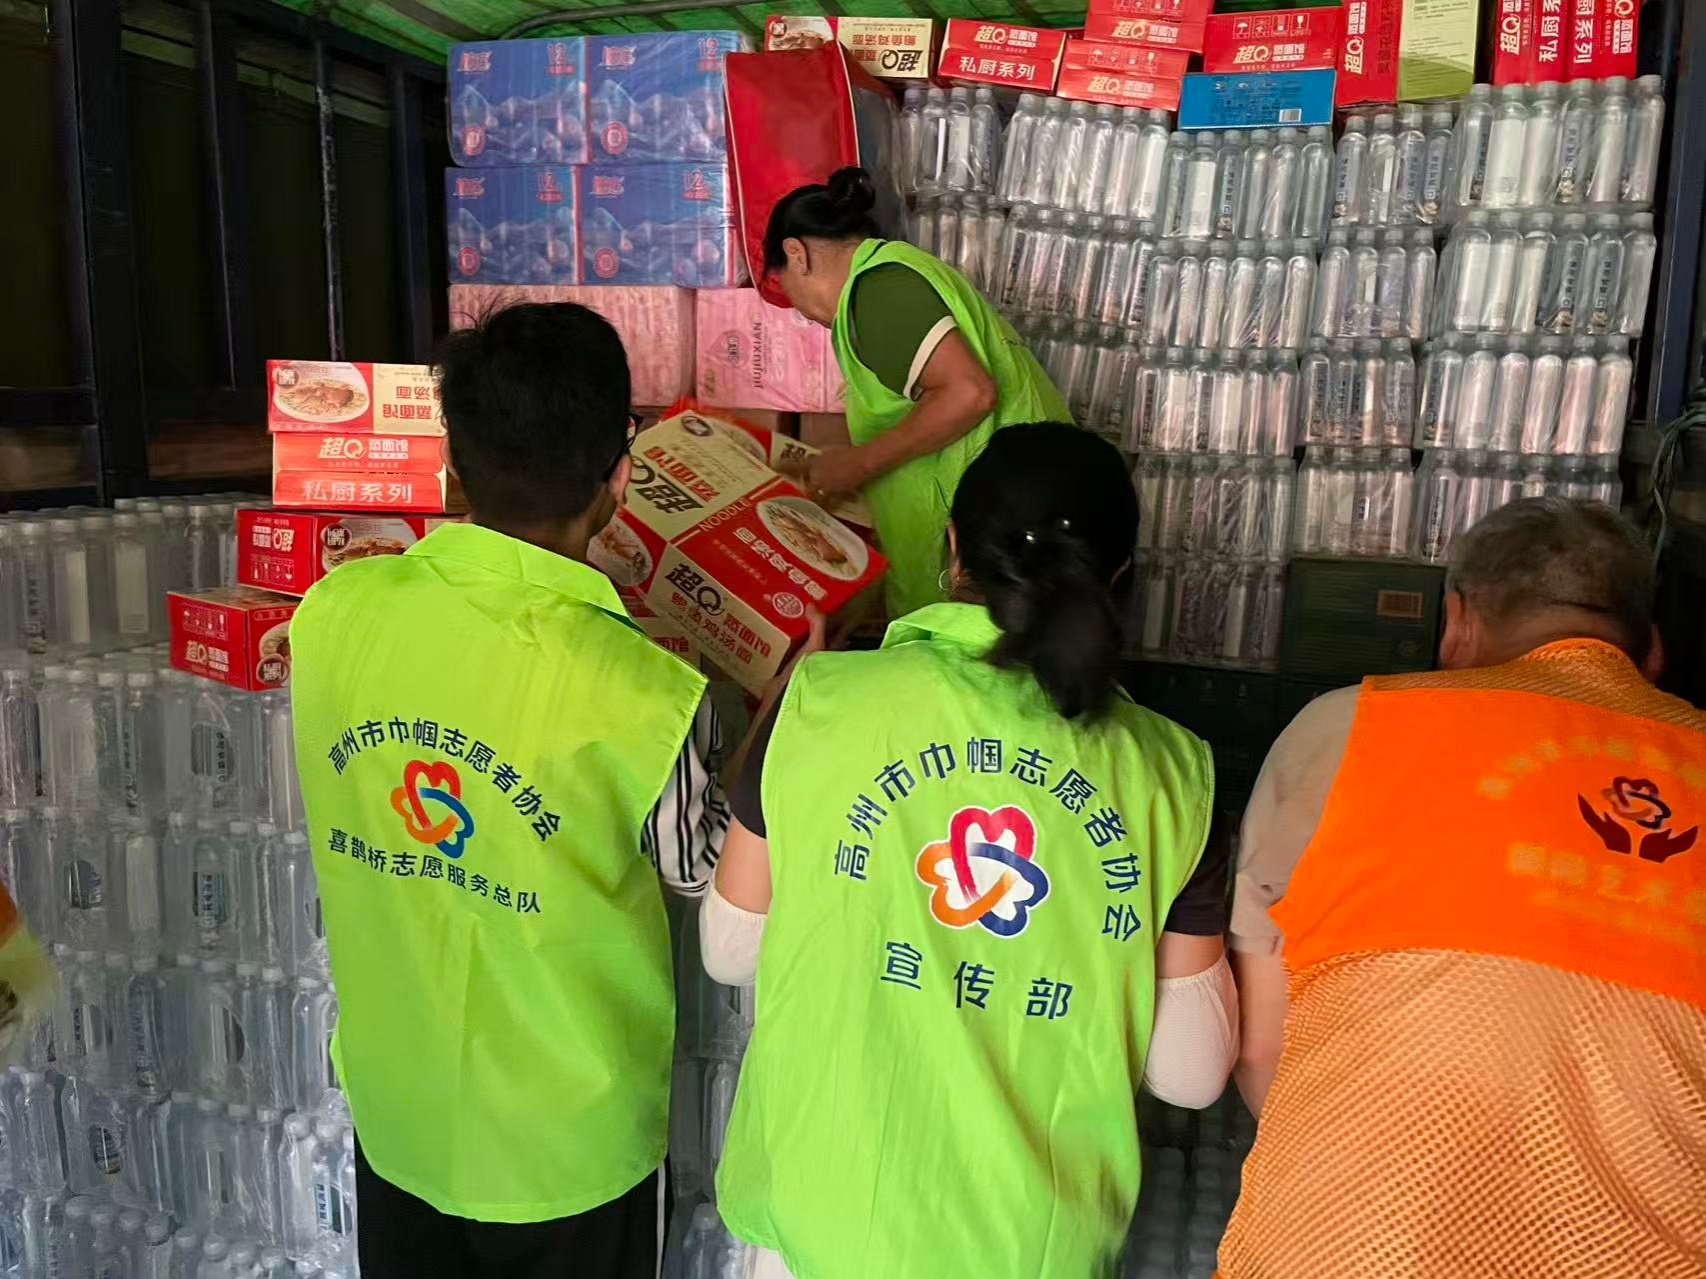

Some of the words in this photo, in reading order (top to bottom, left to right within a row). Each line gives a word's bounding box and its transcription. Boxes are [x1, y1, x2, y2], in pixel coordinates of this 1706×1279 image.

[974, 25, 1007, 44] 超Q
[881, 49, 923, 72] 超Q
[959, 56, 1036, 80] 私厨系列
[1233, 45, 1271, 64] 超Q
[752, 321, 764, 389] JIUJIUXIAN
[318, 437, 368, 460] 超Q
[303, 481, 413, 504] 私厨系列
[665, 562, 725, 617] 超Q
[327, 715, 561, 842] 高州市巾帼志愿者协会
[834, 736, 1141, 942] 高州市巾帼志愿者协会
[328, 827, 542, 914] 喜鹊桥志愿服务总队
[880, 940, 1073, 1021] 宣传部
